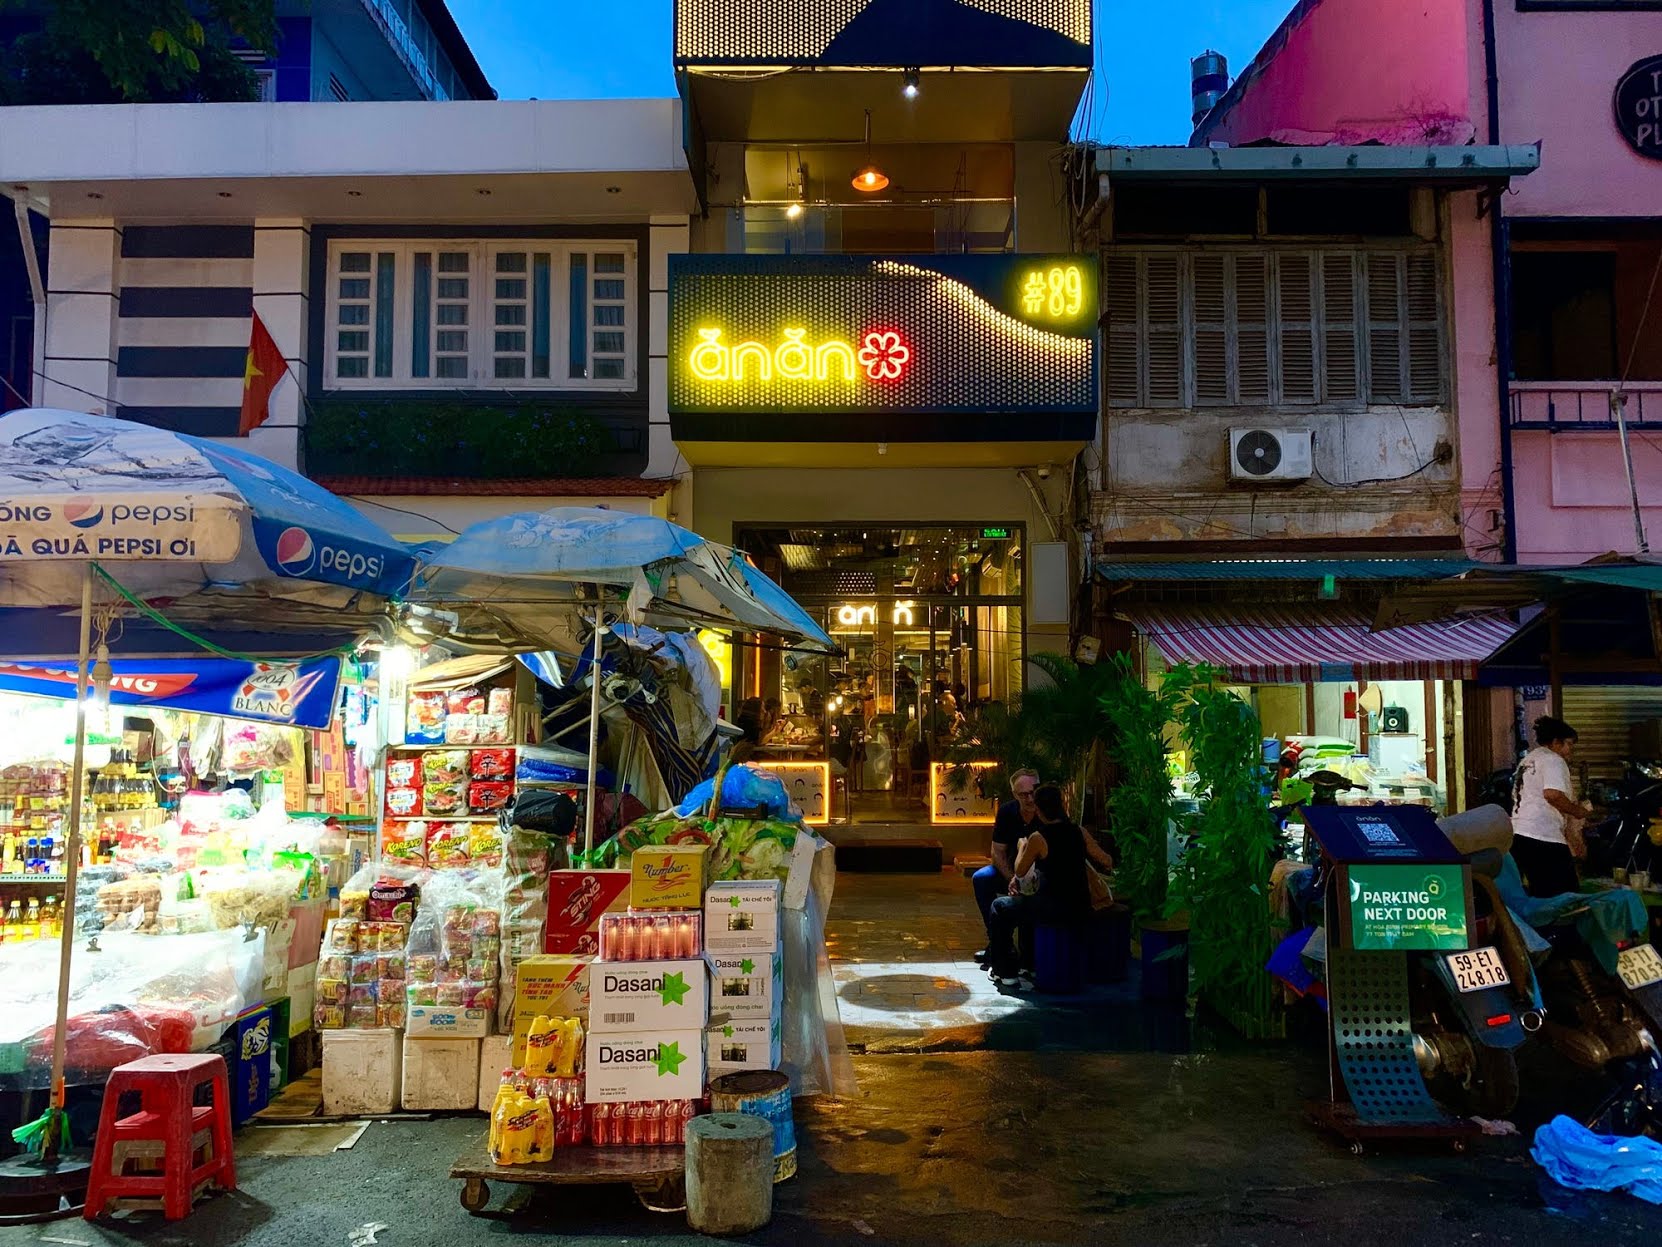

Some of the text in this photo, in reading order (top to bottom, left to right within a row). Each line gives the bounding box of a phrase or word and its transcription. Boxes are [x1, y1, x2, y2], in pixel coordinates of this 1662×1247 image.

[1023, 266, 1082, 316] #89
[111, 502, 194, 526] pepsi
[0, 533, 196, 556] Ã QUÁ PEPSI ƠI
[319, 546, 385, 579] pepsi
[235, 697, 293, 716] BLANC
[474, 838, 502, 852] KOREN
[570, 881, 601, 918] STING
[1363, 891, 1430, 904] PARKING
[1364, 908, 1447, 920] NEXT DOOR
[604, 973, 666, 992] Dasani
[1457, 967, 1506, 990] 248.18
[599, 1043, 661, 1064] Dasani
